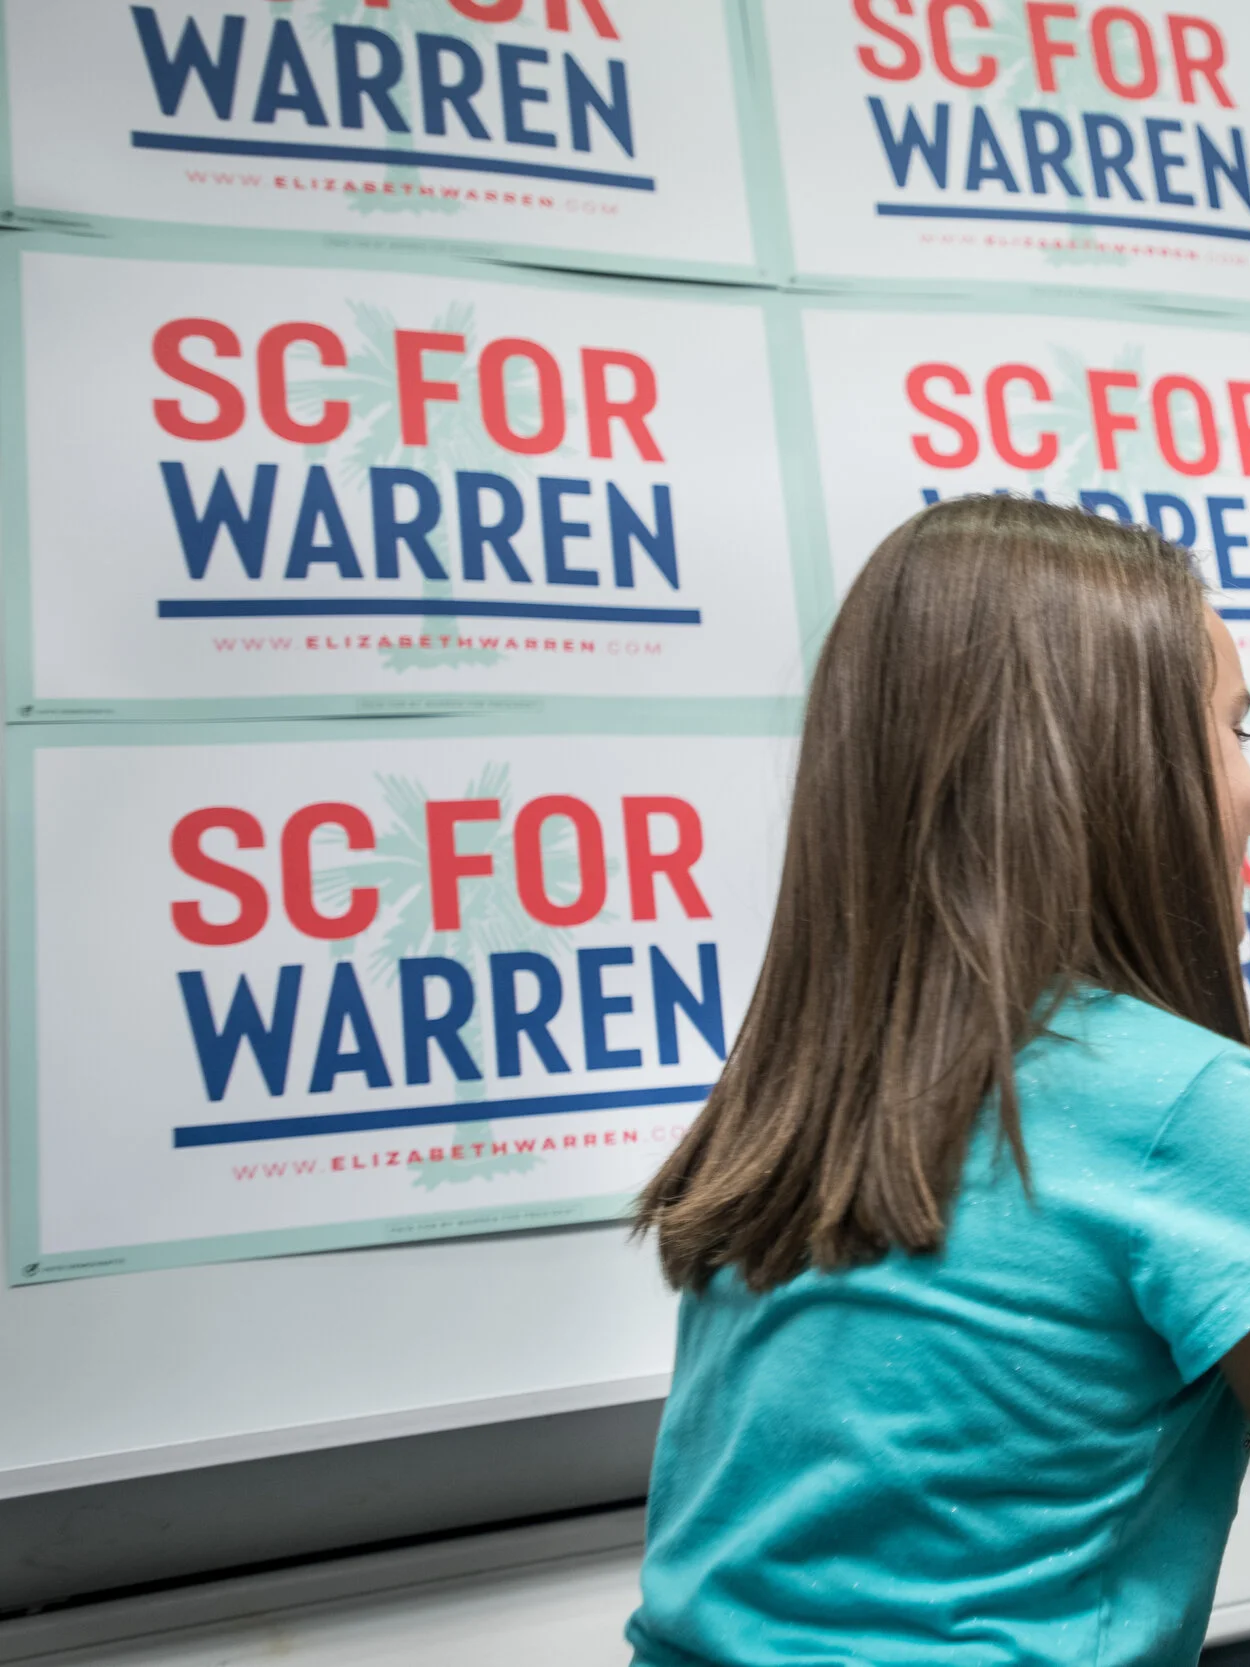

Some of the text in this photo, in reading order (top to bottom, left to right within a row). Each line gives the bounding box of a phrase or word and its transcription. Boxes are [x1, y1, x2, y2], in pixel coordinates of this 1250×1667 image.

[131, 5, 636, 159] WARREN
[852, 0, 1237, 109] SC FOR
[152, 318, 665, 463] SC FOR
[905, 362, 1059, 471] SC
[160, 461, 679, 590] WARREN
[170, 794, 712, 946] SC FOR
[177, 942, 727, 1102] WARREN
